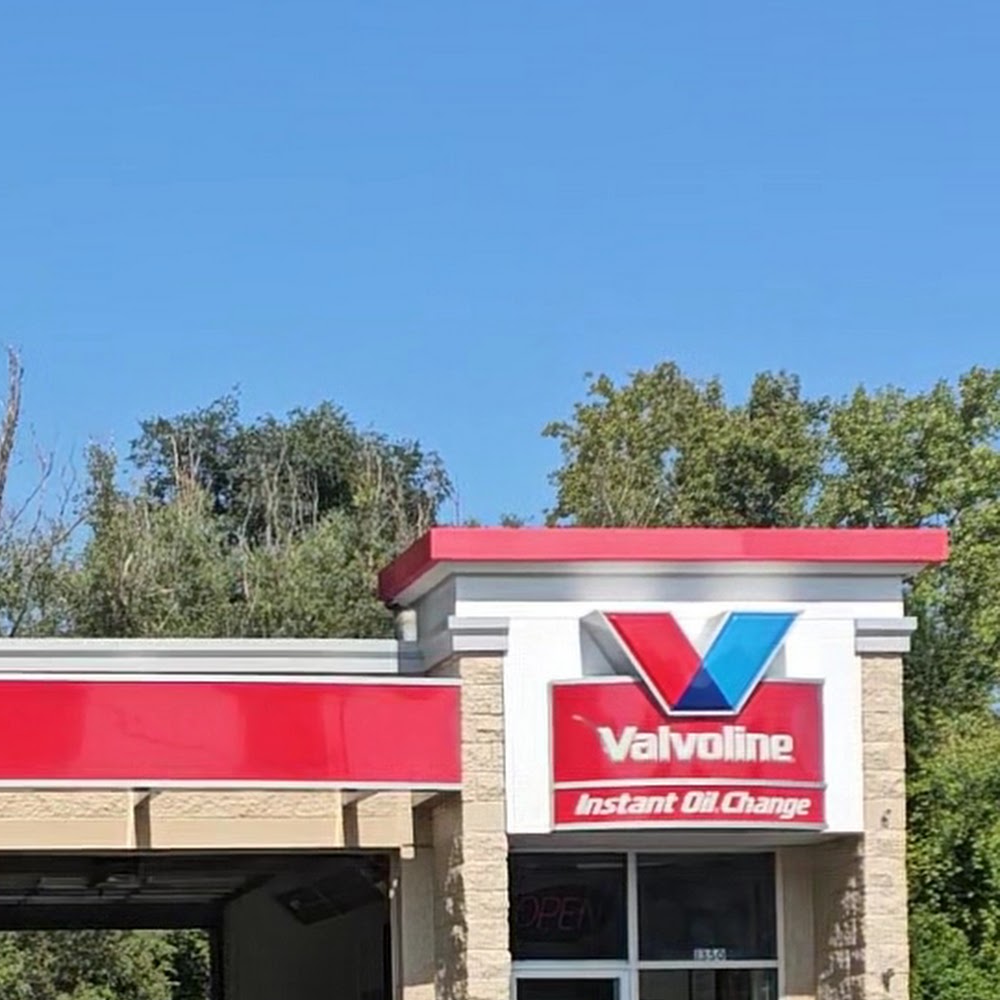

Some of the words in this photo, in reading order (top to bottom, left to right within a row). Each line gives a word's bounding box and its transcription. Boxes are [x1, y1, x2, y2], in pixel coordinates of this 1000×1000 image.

[597, 725, 795, 763] Valvoline
[575, 792, 677, 816] Instant
[681, 790, 720, 814] Oil
[721, 790, 812, 819] Change
